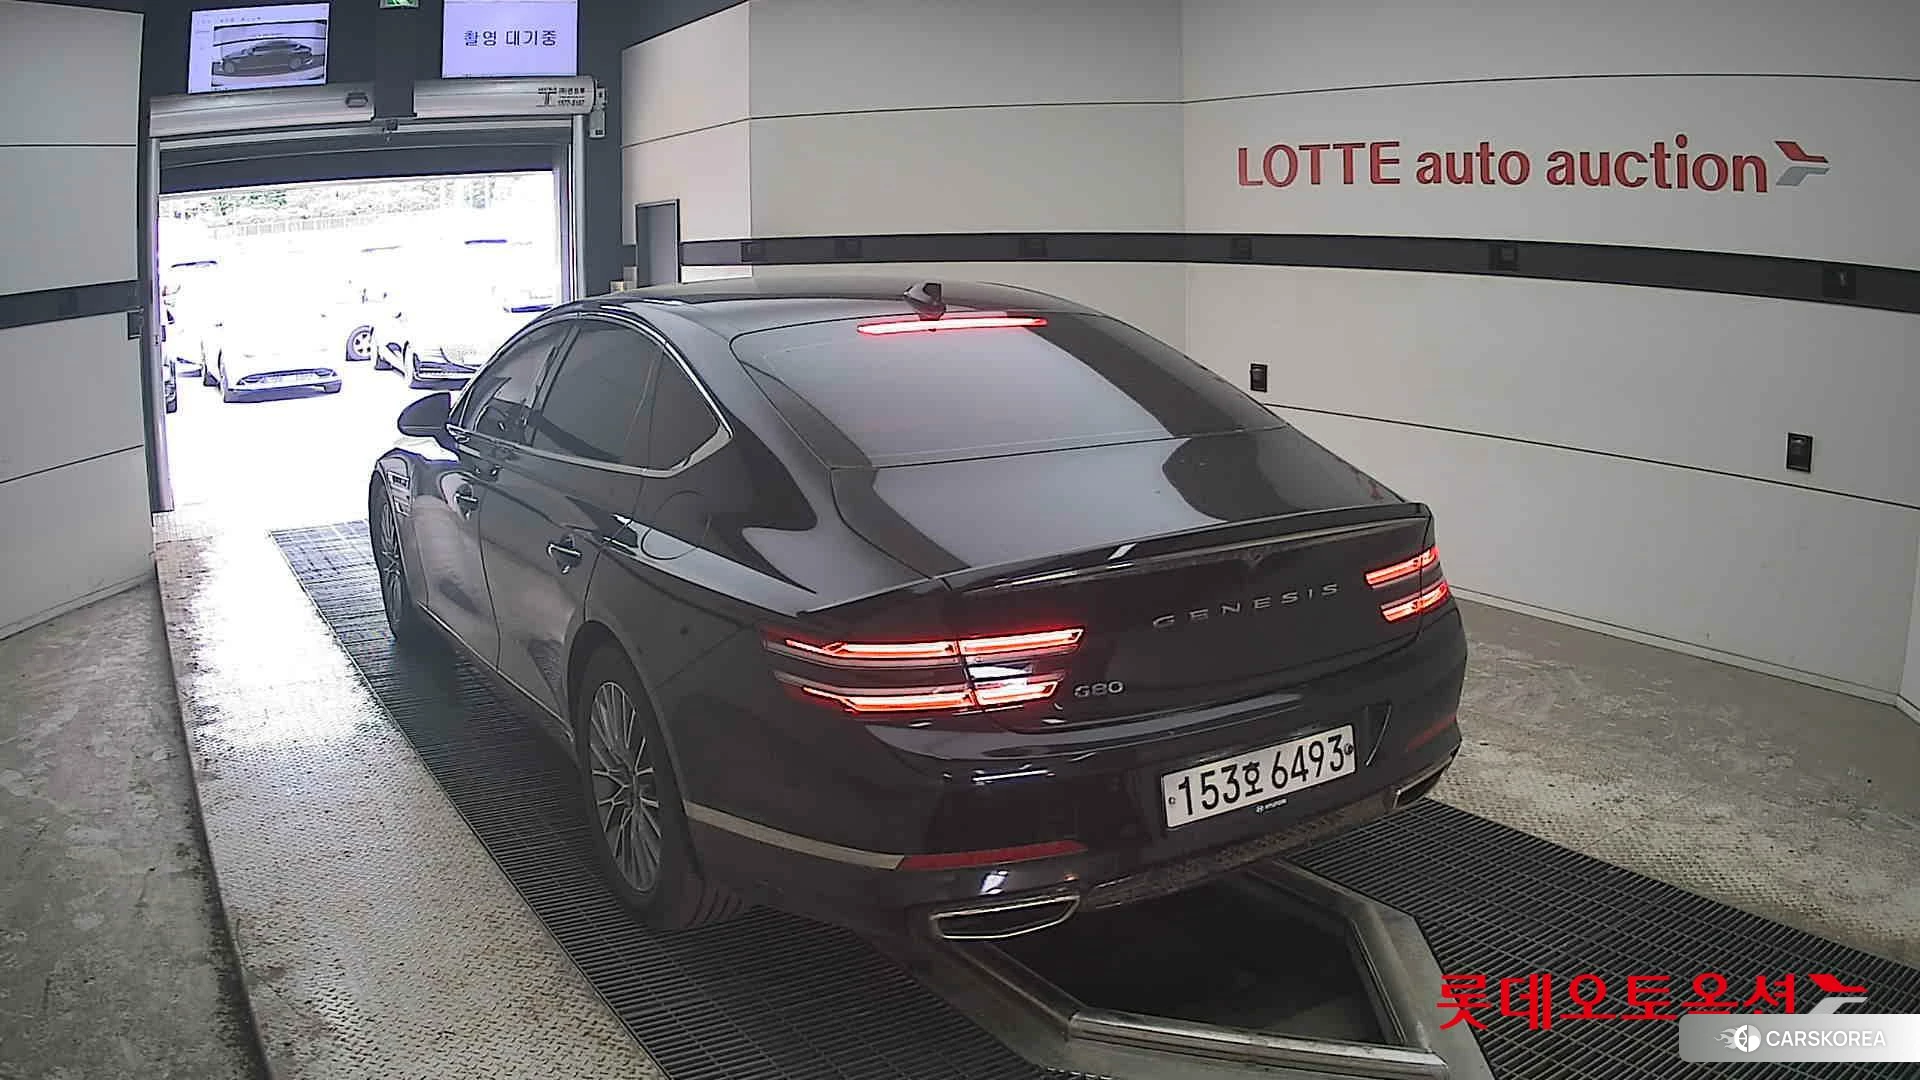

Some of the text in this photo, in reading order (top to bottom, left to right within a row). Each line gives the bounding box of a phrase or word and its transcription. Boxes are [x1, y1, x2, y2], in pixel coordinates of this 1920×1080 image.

[464, 29, 557, 47] 촬영 대기중
[1238, 133, 1768, 193] LOTTE auto auction
[1152, 582, 1339, 629] GENESIS
[1073, 680, 1125, 698] G80
[1178, 734, 1345, 816] 153호 6493
